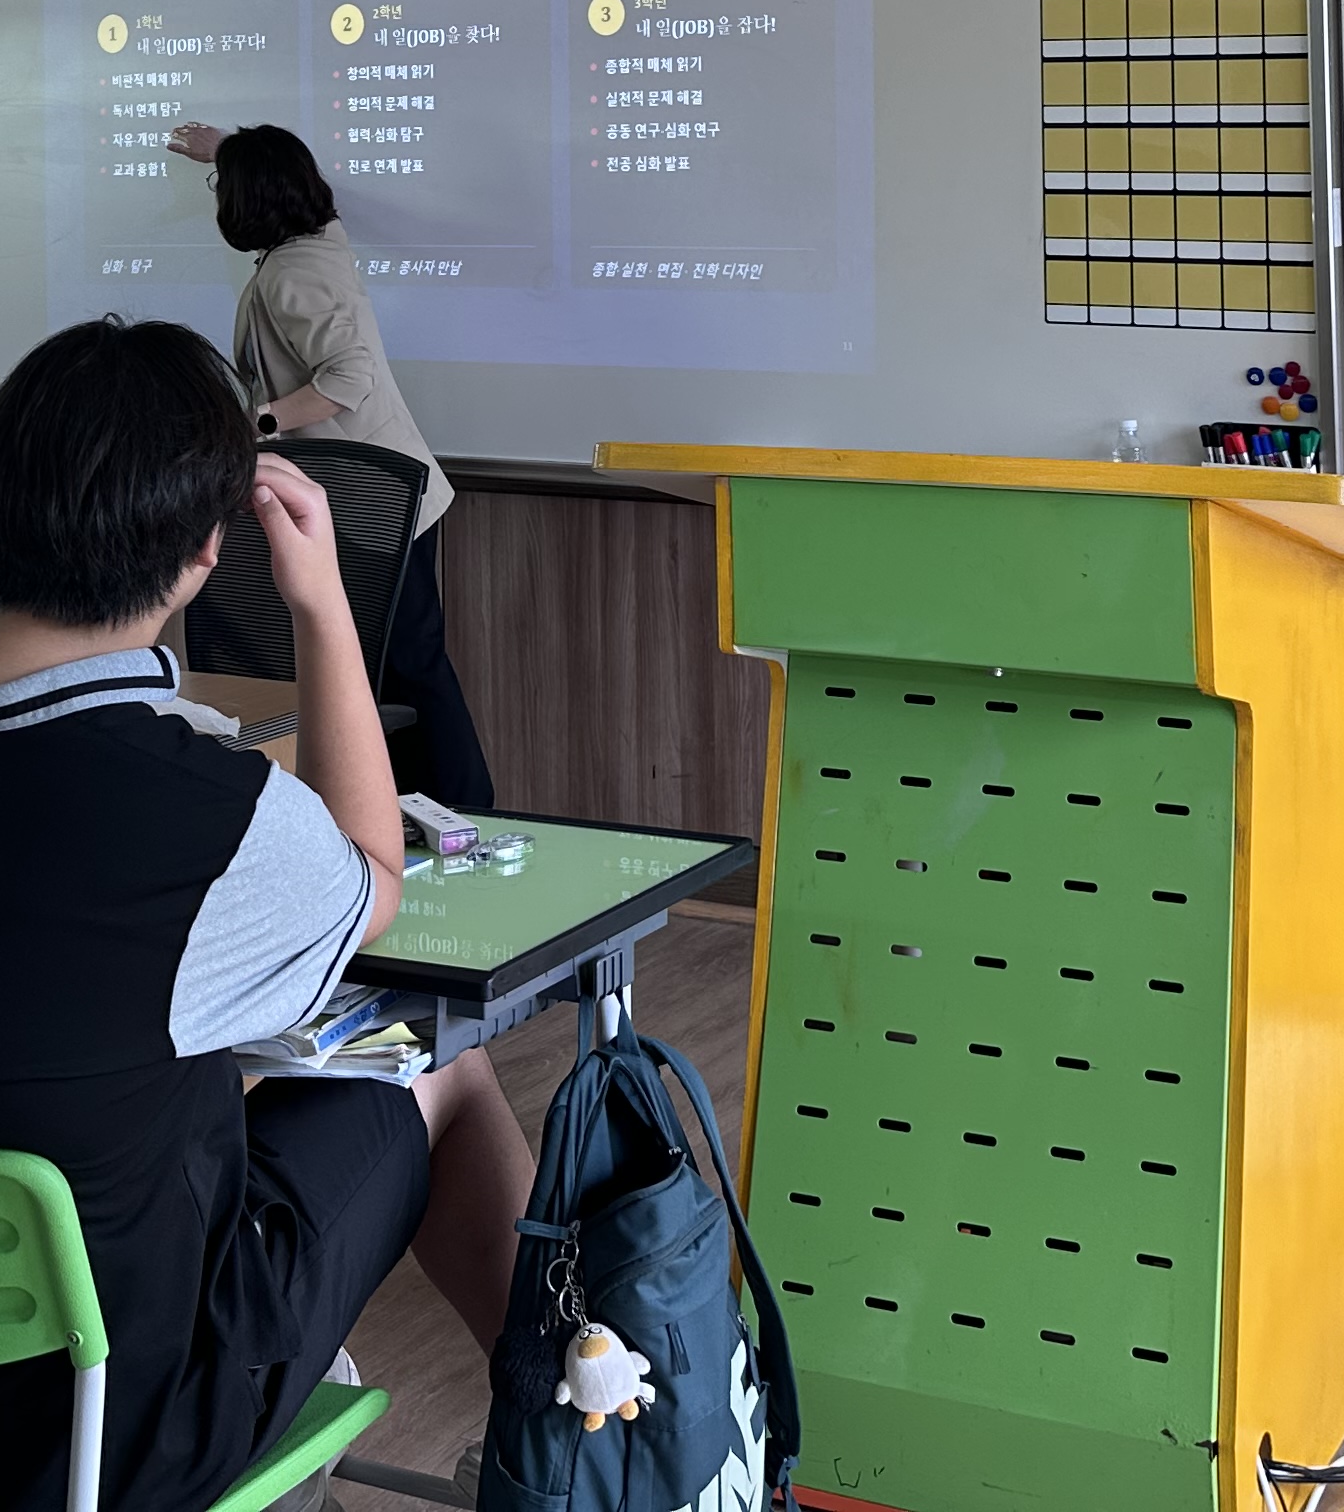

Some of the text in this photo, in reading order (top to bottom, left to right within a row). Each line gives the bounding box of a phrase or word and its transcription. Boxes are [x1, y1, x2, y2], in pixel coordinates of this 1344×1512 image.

[372, 4, 403, 20] 2학년
[600, 6, 611, 23] 3
[136, 15, 163, 30] 1학년
[343, 16, 352, 32] 2
[636, 13, 776, 40] 내 일(JOB)을 잡다!
[109, 27, 117, 41] 1
[374, 24, 500, 48] 내 일(JOB)을 찾다!
[137, 33, 266, 55] 내 일(JOB)을 꿈꾸다!
[347, 64, 434, 81] 창의적 매체 읽기
[605, 56, 702, 75] 종합적 매체 읽기
[111, 71, 193, 88] 비판적 매체 읽기
[347, 95, 435, 112] 창의적 문제 해결
[605, 90, 703, 107] 실천적 문제 해결
[112, 101, 182, 118] 독서 연계 탐구
[400, 126, 424, 143] 탐구
[605, 124, 632, 140] 공동
[693, 121, 720, 139] 연구
[113, 163, 135, 176] 교과
[137, 162, 159, 177] 융합
[348, 159, 424, 175] 진로 연계 발표
[606, 155, 691, 172] 전공 심화 발표
[102, 259, 153, 274] 심화 탐구
[367, 260, 391, 275] 진로
[438, 260, 463, 276] 만남
[657, 262, 684, 278] 면접
[692, 263, 720, 279] 진학
[722, 263, 764, 280] 디자인
[370, 1002, 380, 1014] 3
